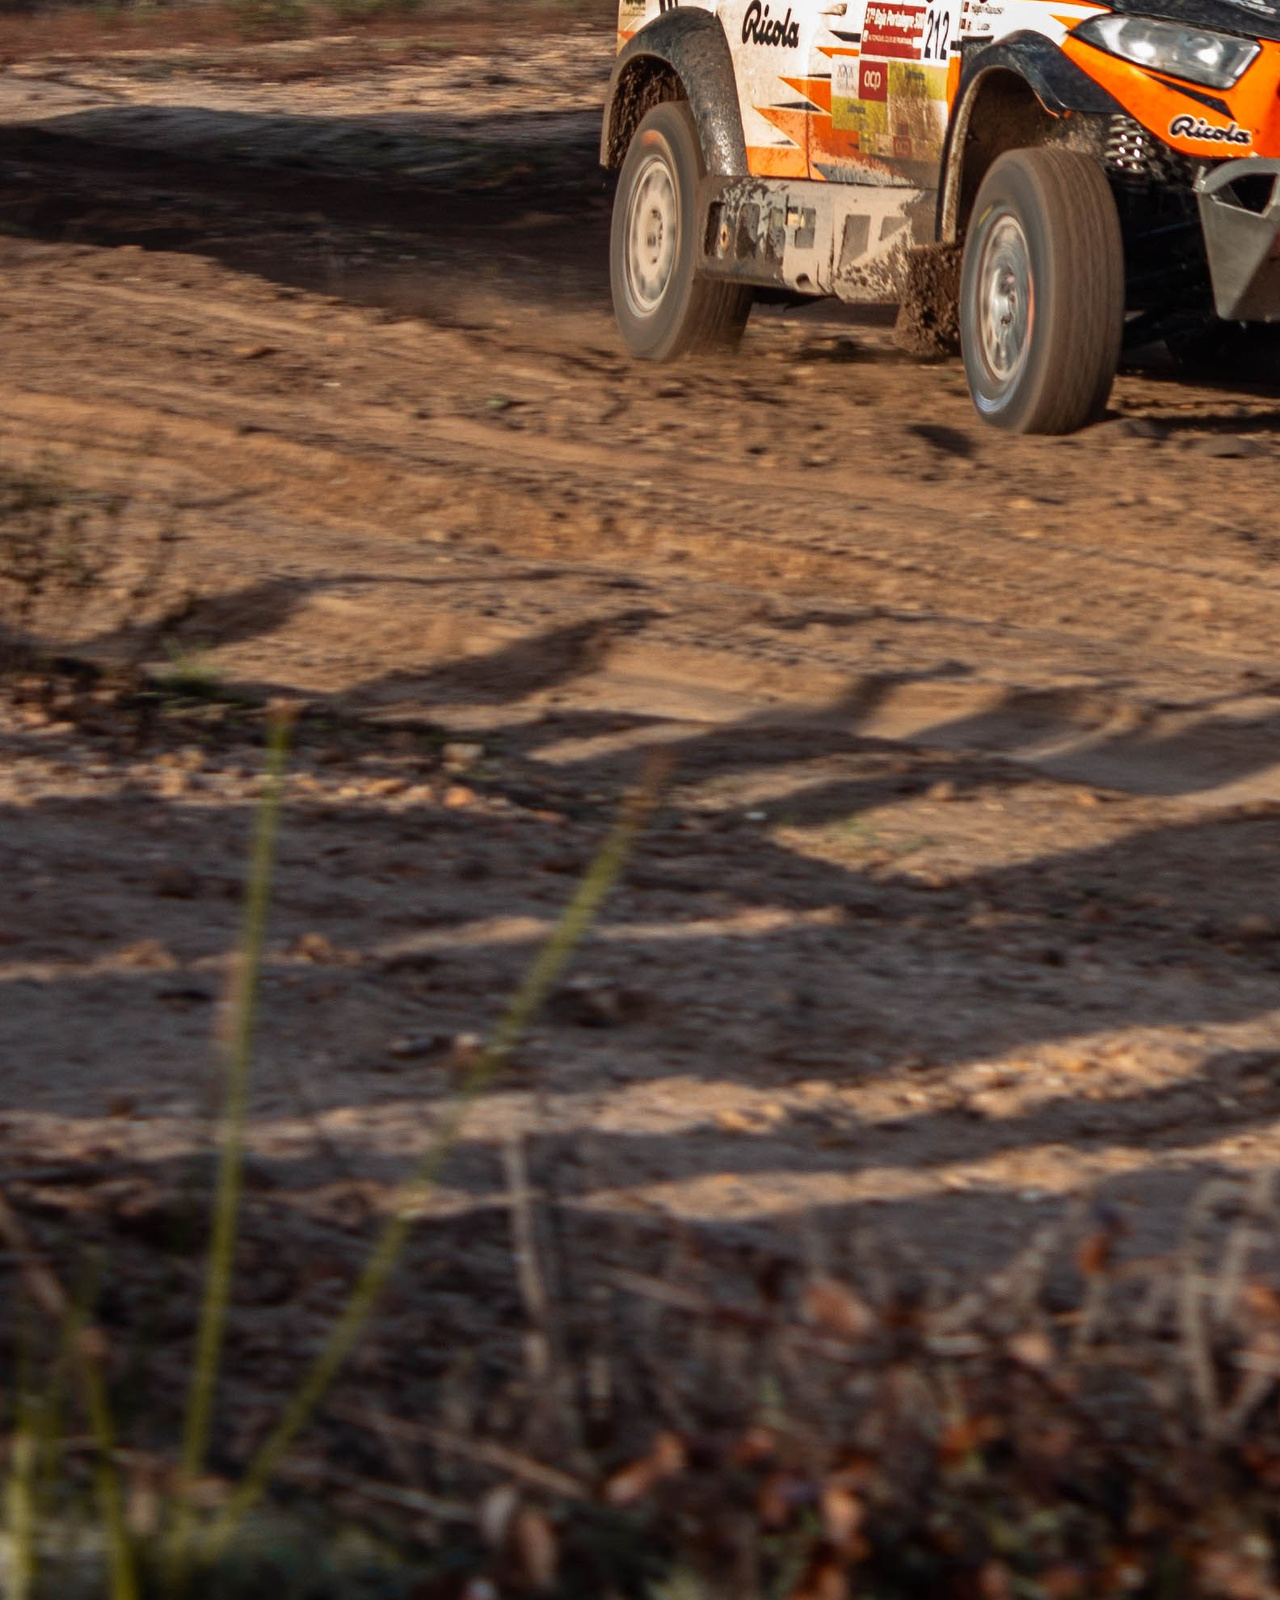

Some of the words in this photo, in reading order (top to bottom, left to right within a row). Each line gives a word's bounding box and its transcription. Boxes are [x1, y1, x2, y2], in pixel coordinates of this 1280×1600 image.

[742, 0, 799, 49] Ricola
[924, 9, 950, 60] 212
[864, 69, 881, 91] acp
[1169, 114, 1252, 145] Ricola
